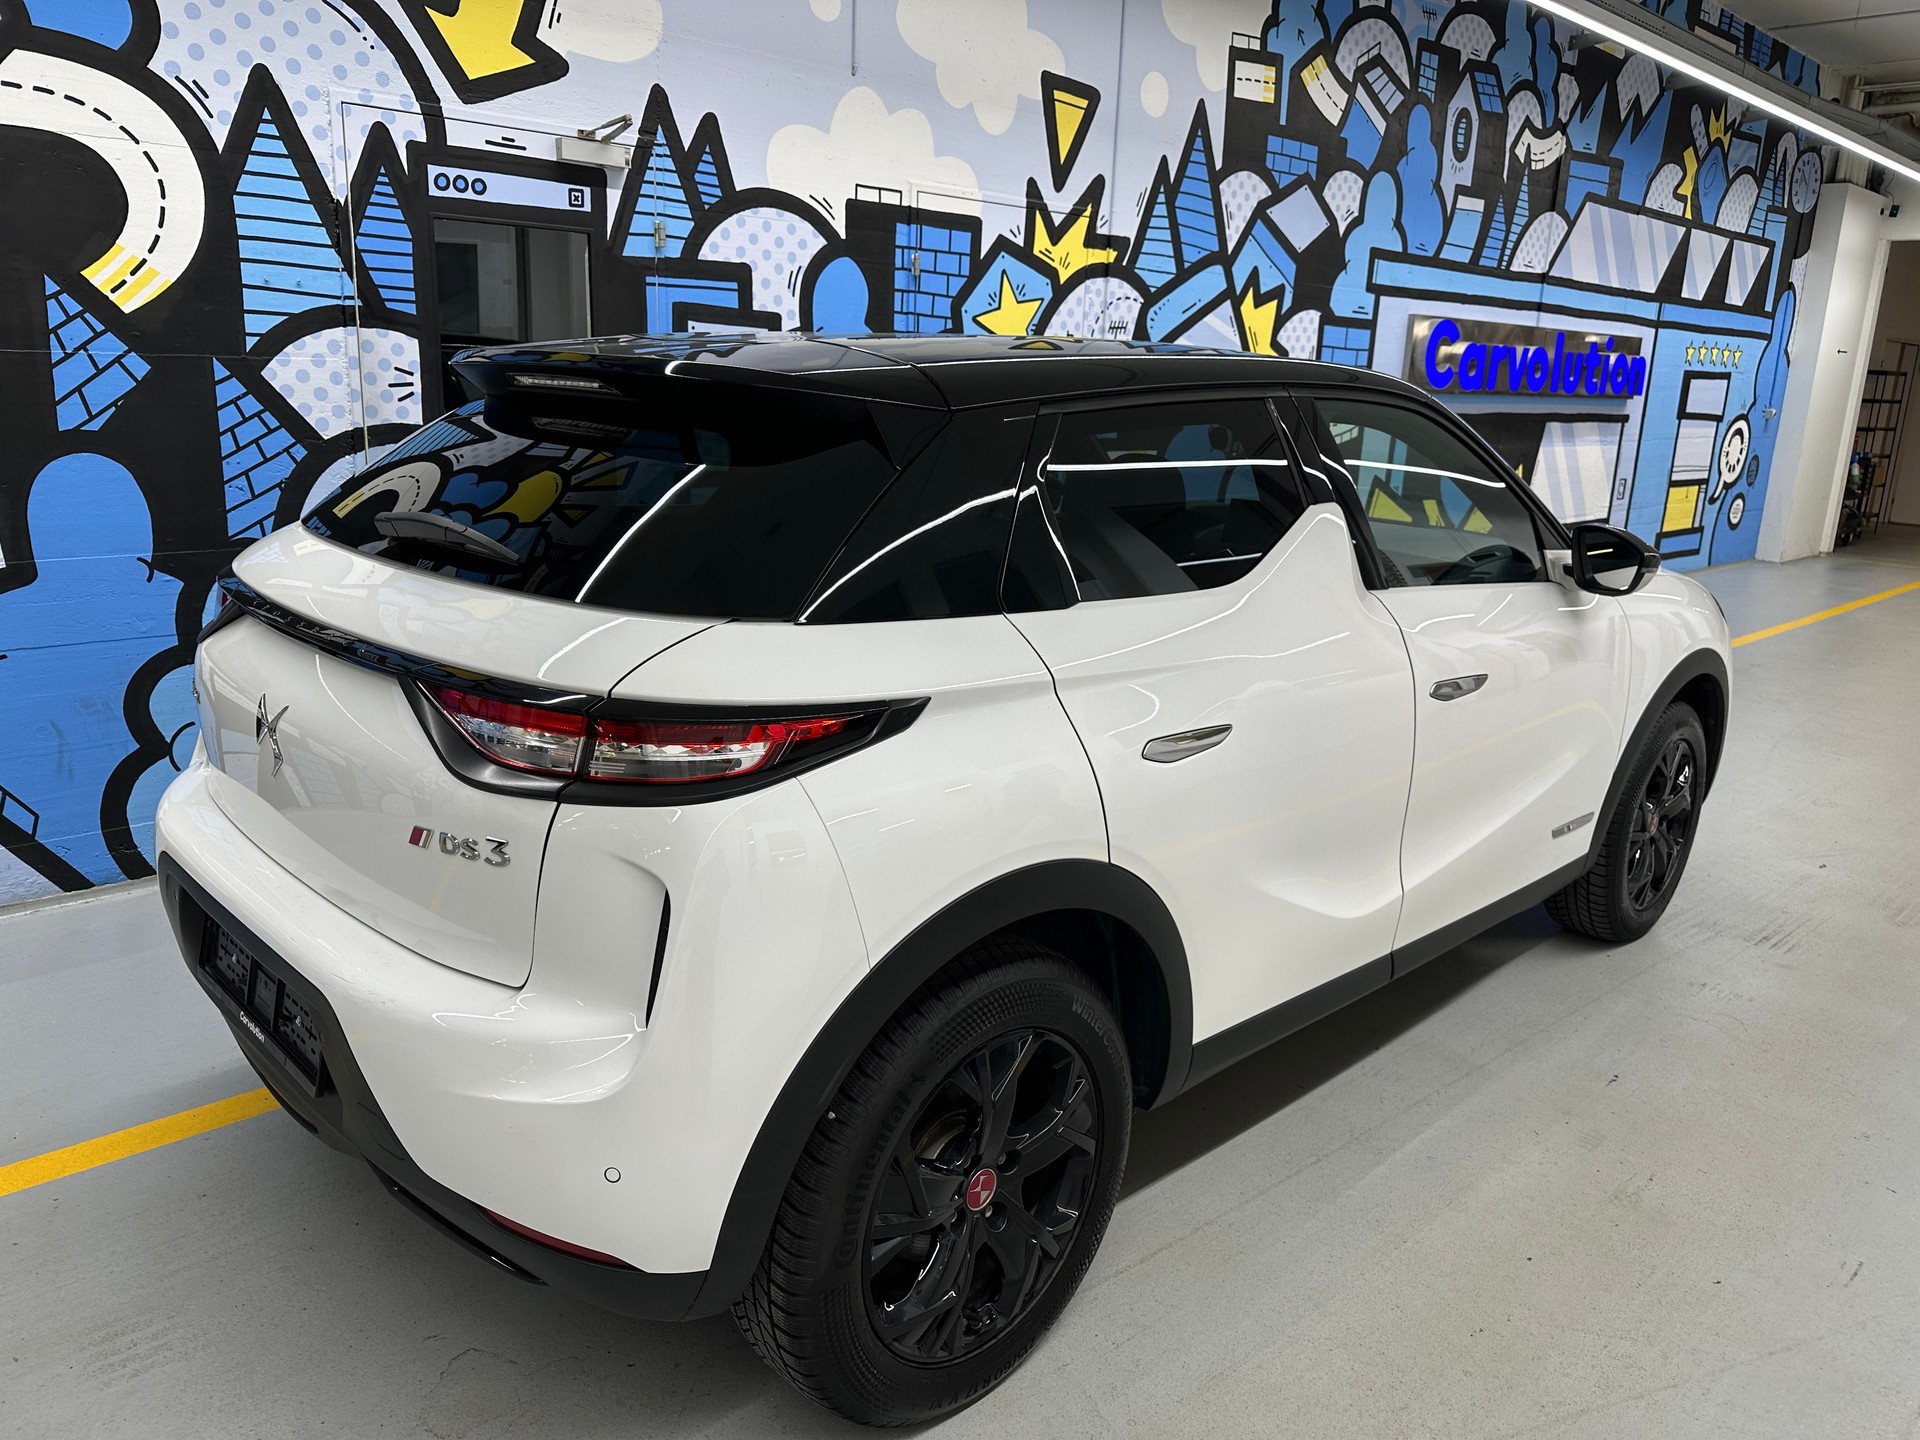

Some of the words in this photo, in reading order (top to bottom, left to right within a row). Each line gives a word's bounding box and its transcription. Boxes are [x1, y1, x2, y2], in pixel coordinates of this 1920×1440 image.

[1425, 319, 1646, 396] Carvolution
[438, 831, 480, 862] DS
[484, 836, 511, 868] 3
